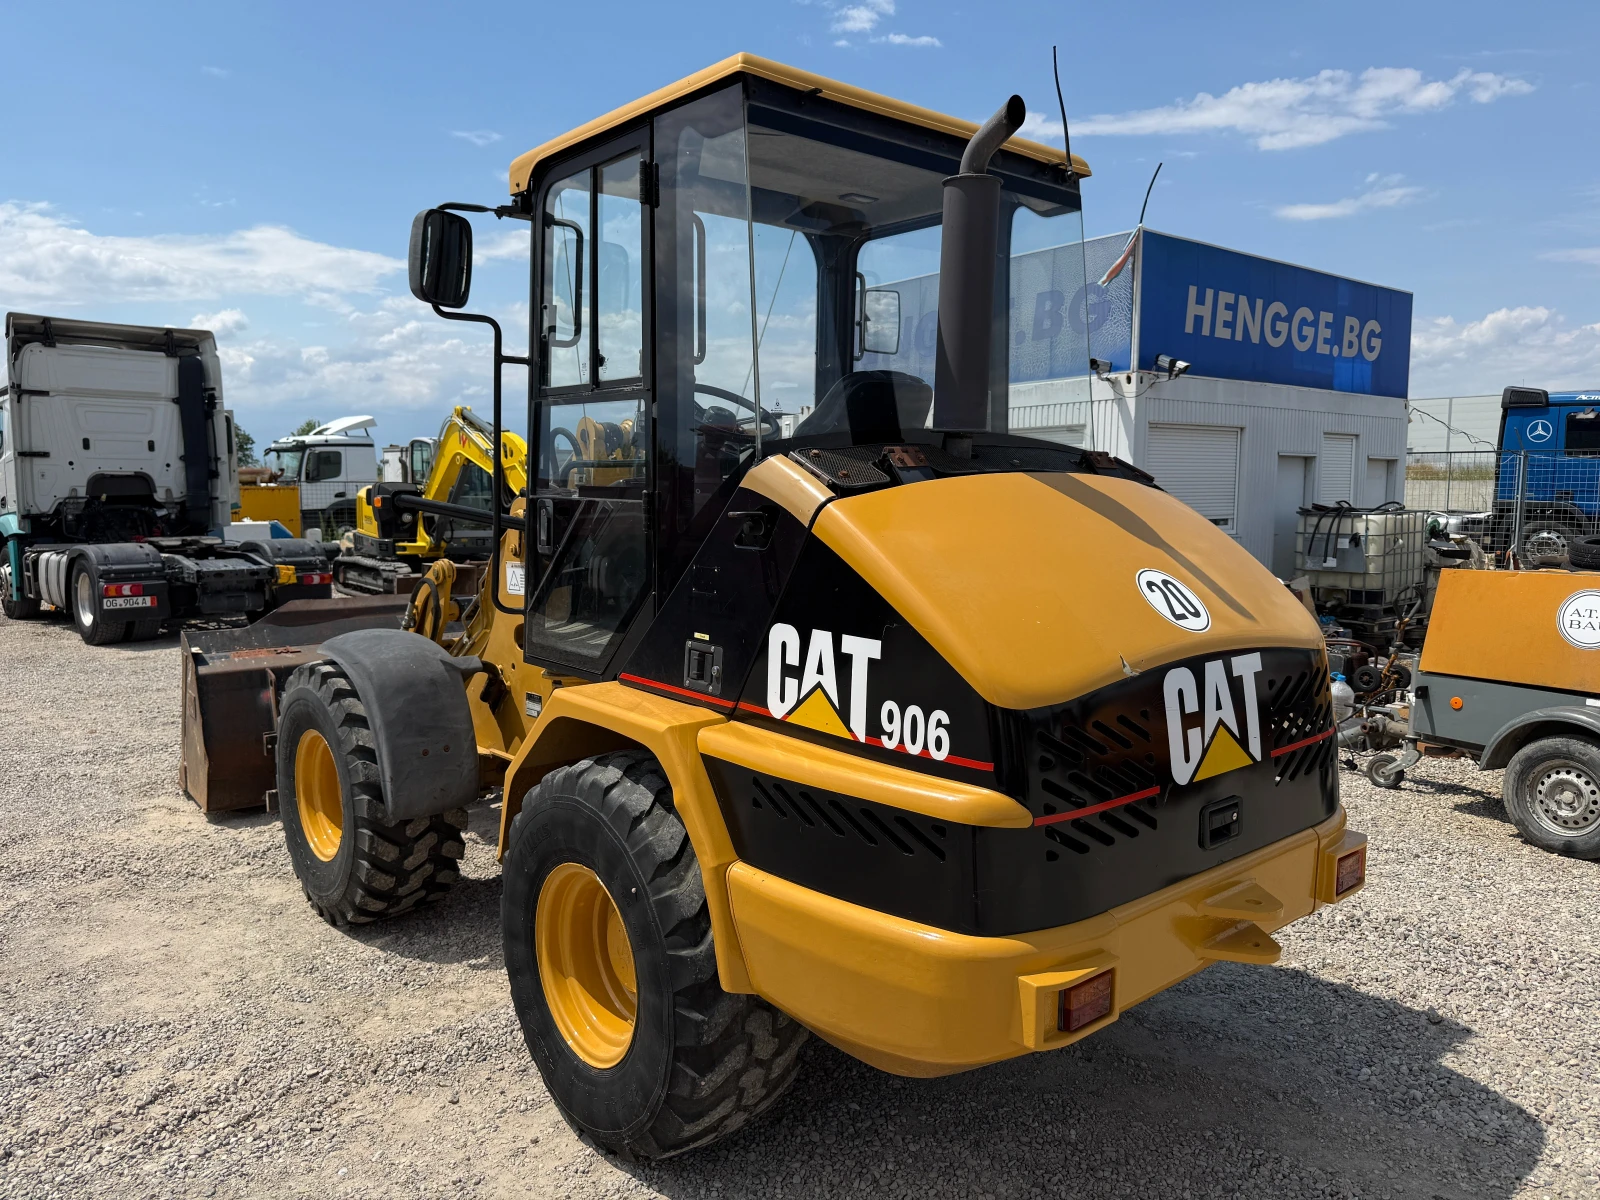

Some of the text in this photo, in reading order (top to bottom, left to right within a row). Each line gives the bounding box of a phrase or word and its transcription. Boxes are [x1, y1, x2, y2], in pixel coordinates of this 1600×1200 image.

[1184, 285, 1382, 361] HENGGE.BG
[1145, 578, 1201, 621] 20
[1567, 619, 1600, 631] BA
[767, 622, 950, 761] CAT 906
[1163, 652, 1263, 786] CAT
